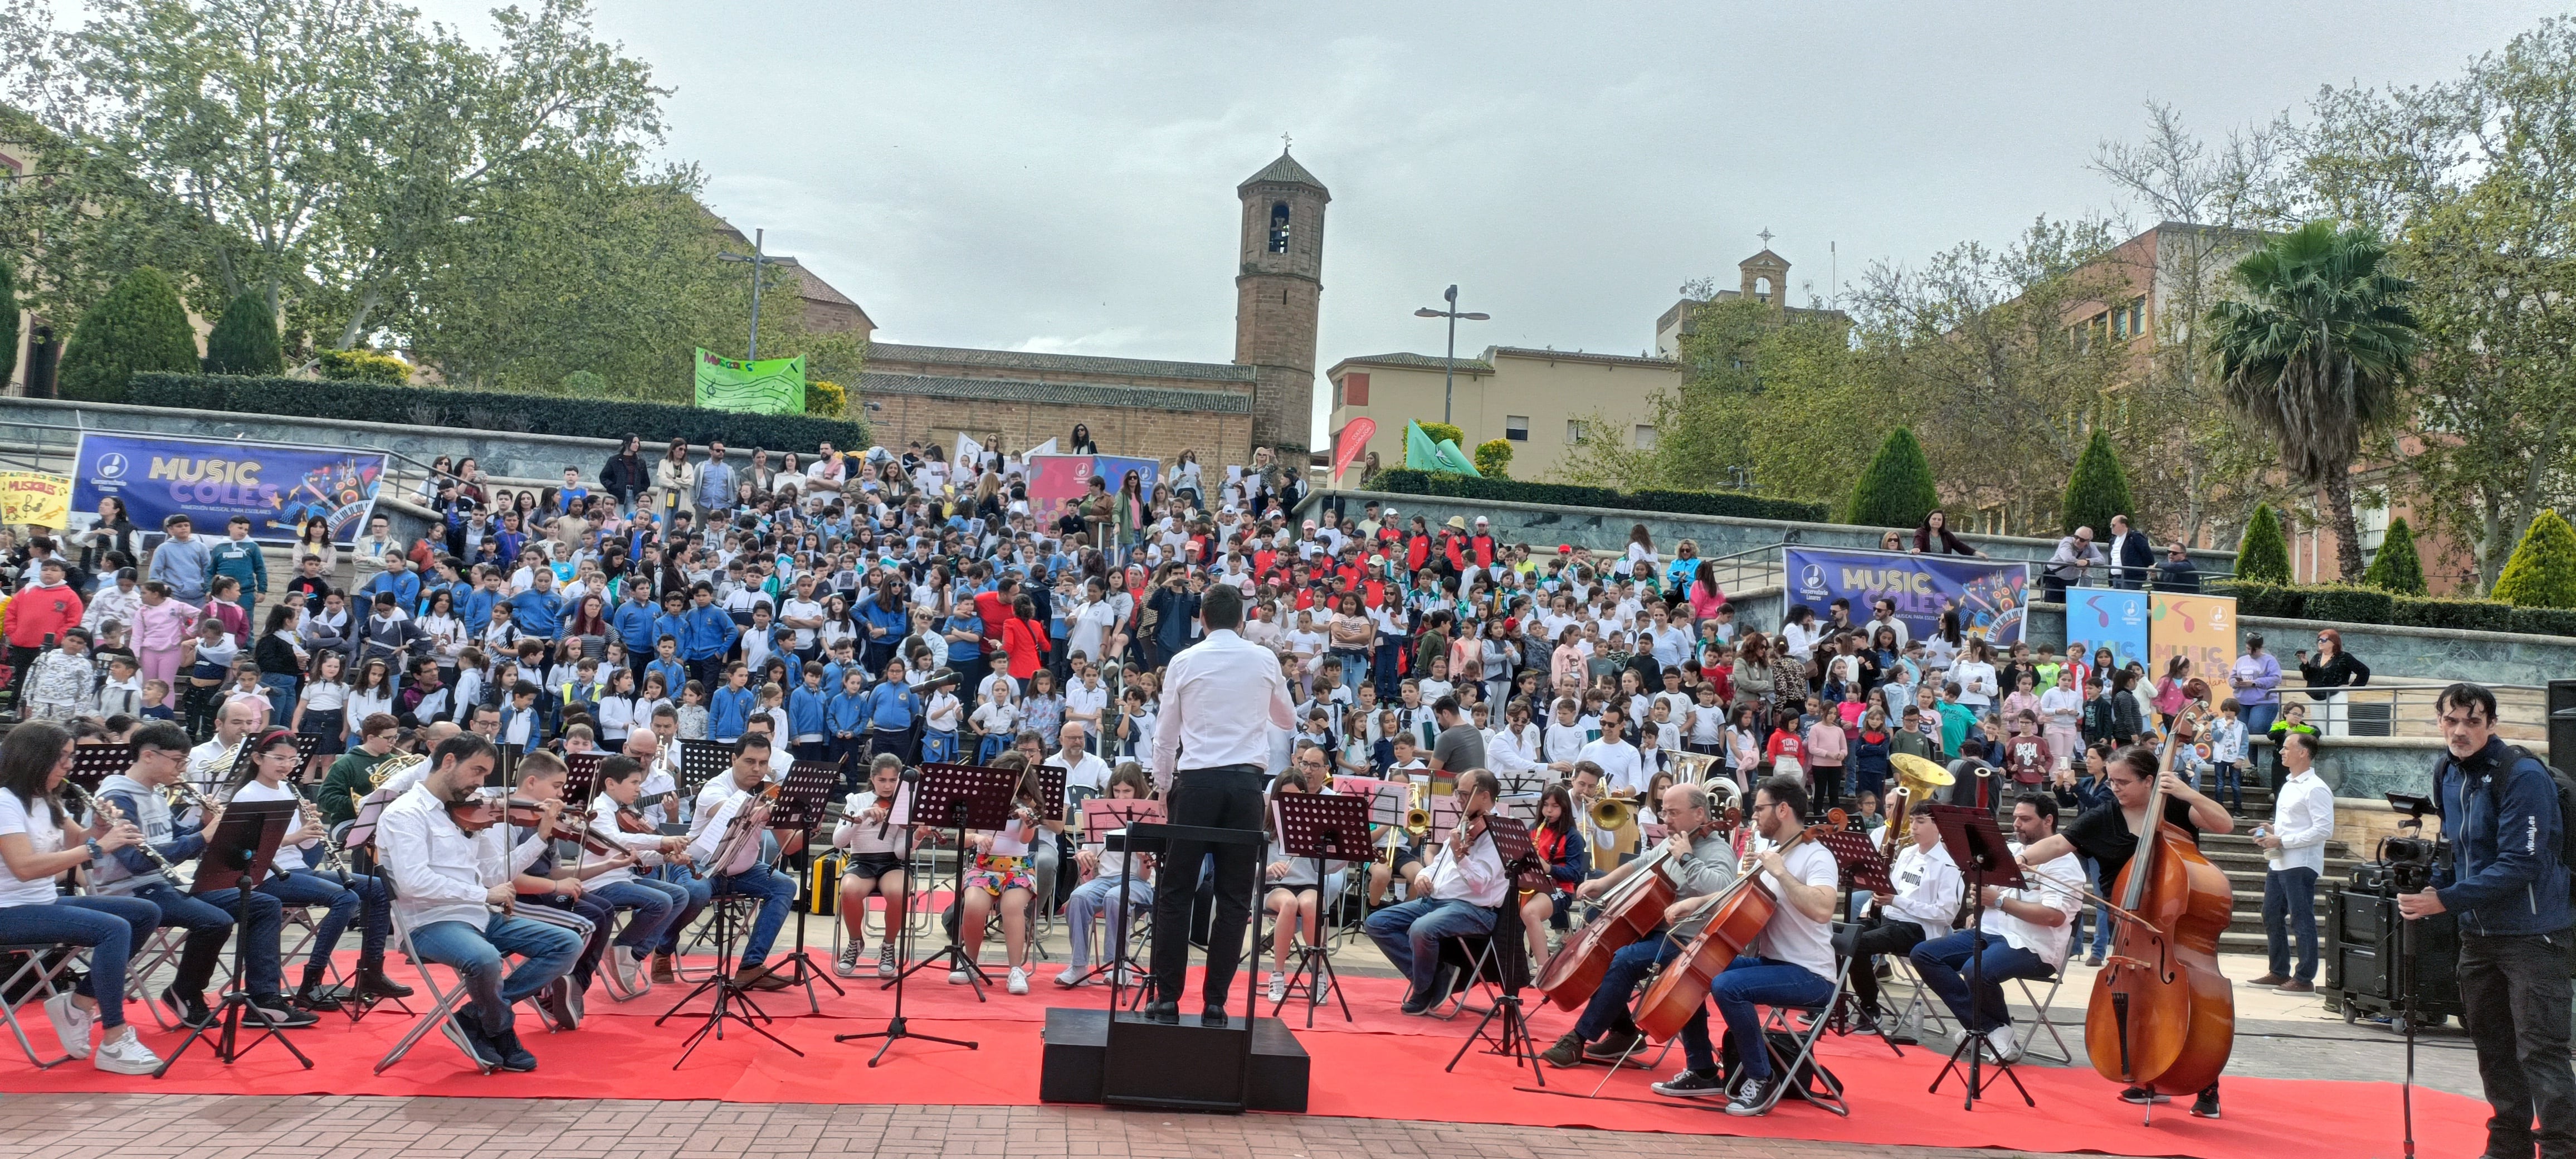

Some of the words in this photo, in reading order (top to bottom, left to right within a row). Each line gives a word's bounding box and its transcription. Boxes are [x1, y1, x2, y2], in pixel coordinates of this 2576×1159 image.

[149, 456, 262, 486] MUSIC
[169, 479, 279, 508] COLES
[1800, 587, 1828, 596] Conservatorio
[1842, 568, 1931, 594] MUSIC
[1862, 588, 1950, 614] COLES
[2155, 644, 2223, 663] MUSIC
[2525, 816, 2538, 851] visualy.es
[1901, 871, 1921, 887] PUMA
